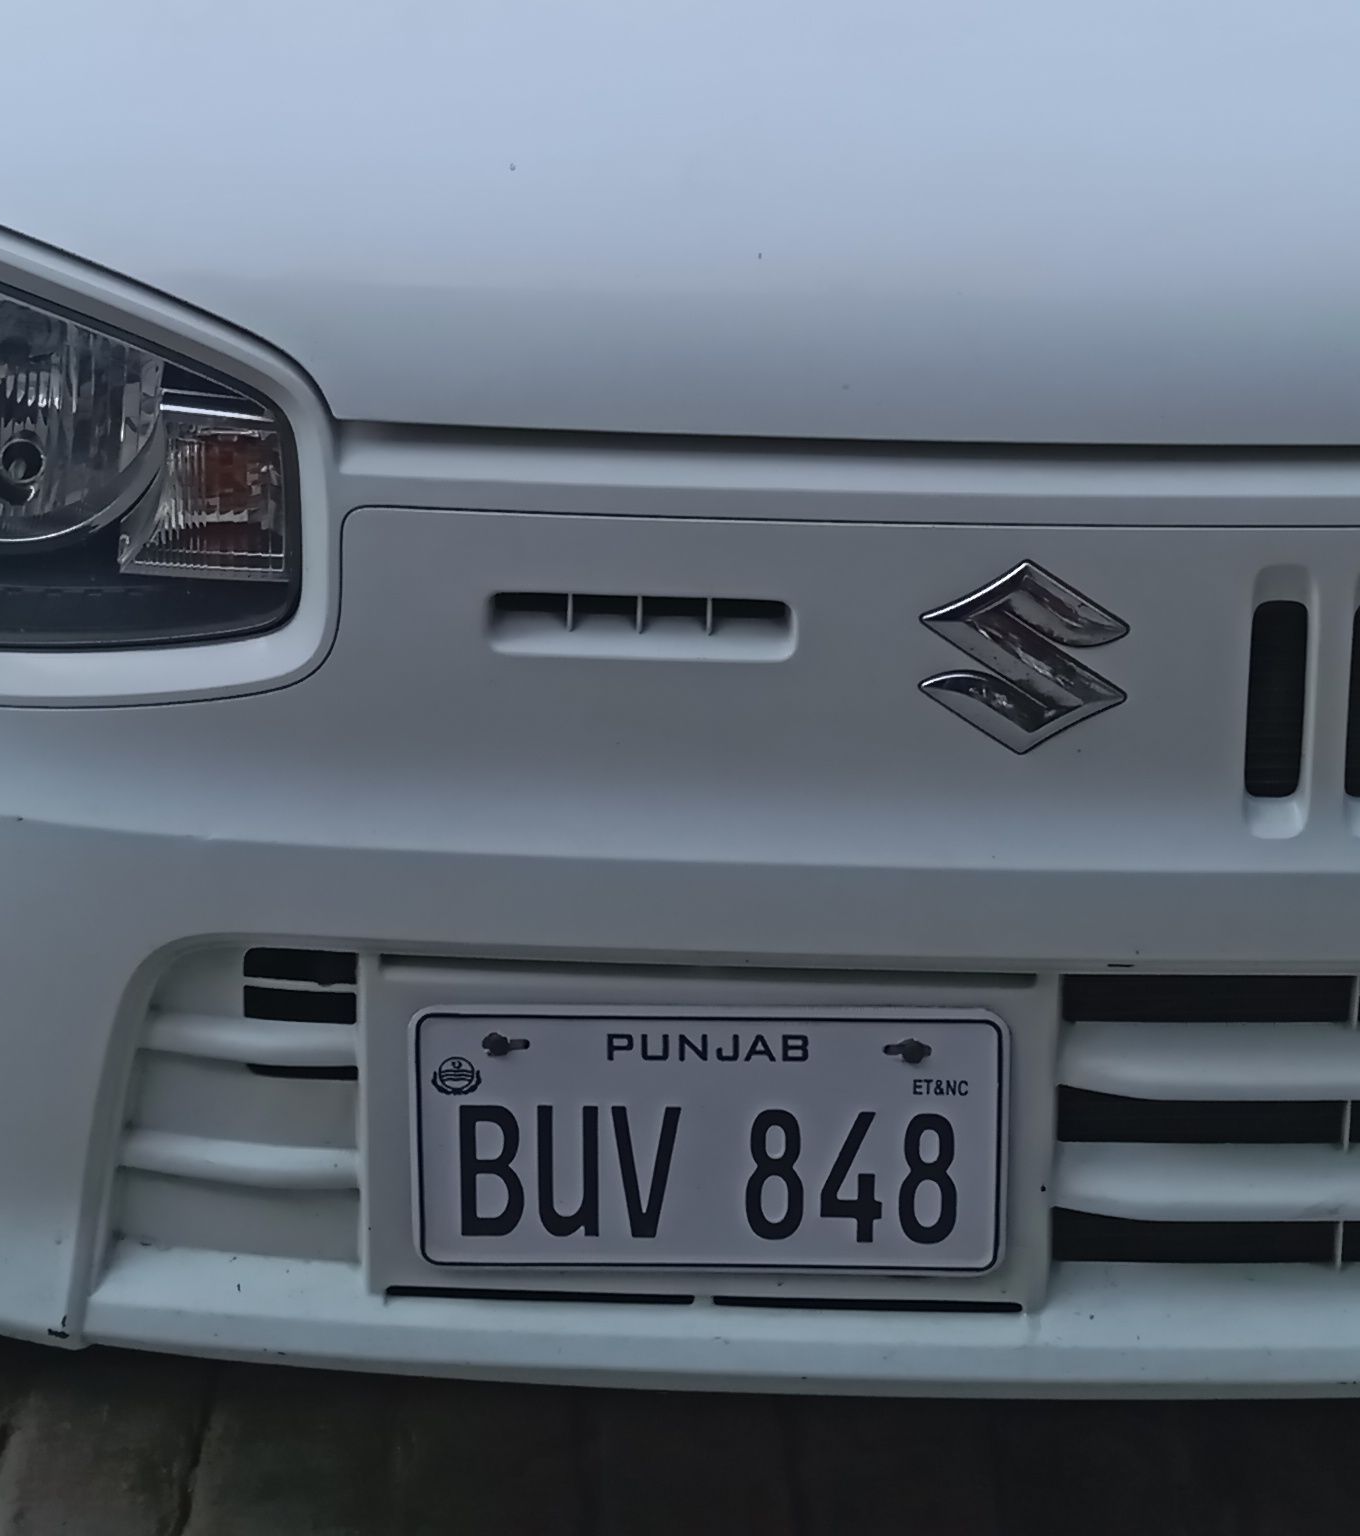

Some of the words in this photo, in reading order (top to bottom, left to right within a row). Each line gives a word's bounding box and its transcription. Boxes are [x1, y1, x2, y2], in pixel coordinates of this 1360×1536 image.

[606, 1033, 810, 1063] PUNJAB
[912, 1078, 970, 1098] ET&NC
[459, 1104, 682, 1239] BUV
[745, 1108, 958, 1245] 848
